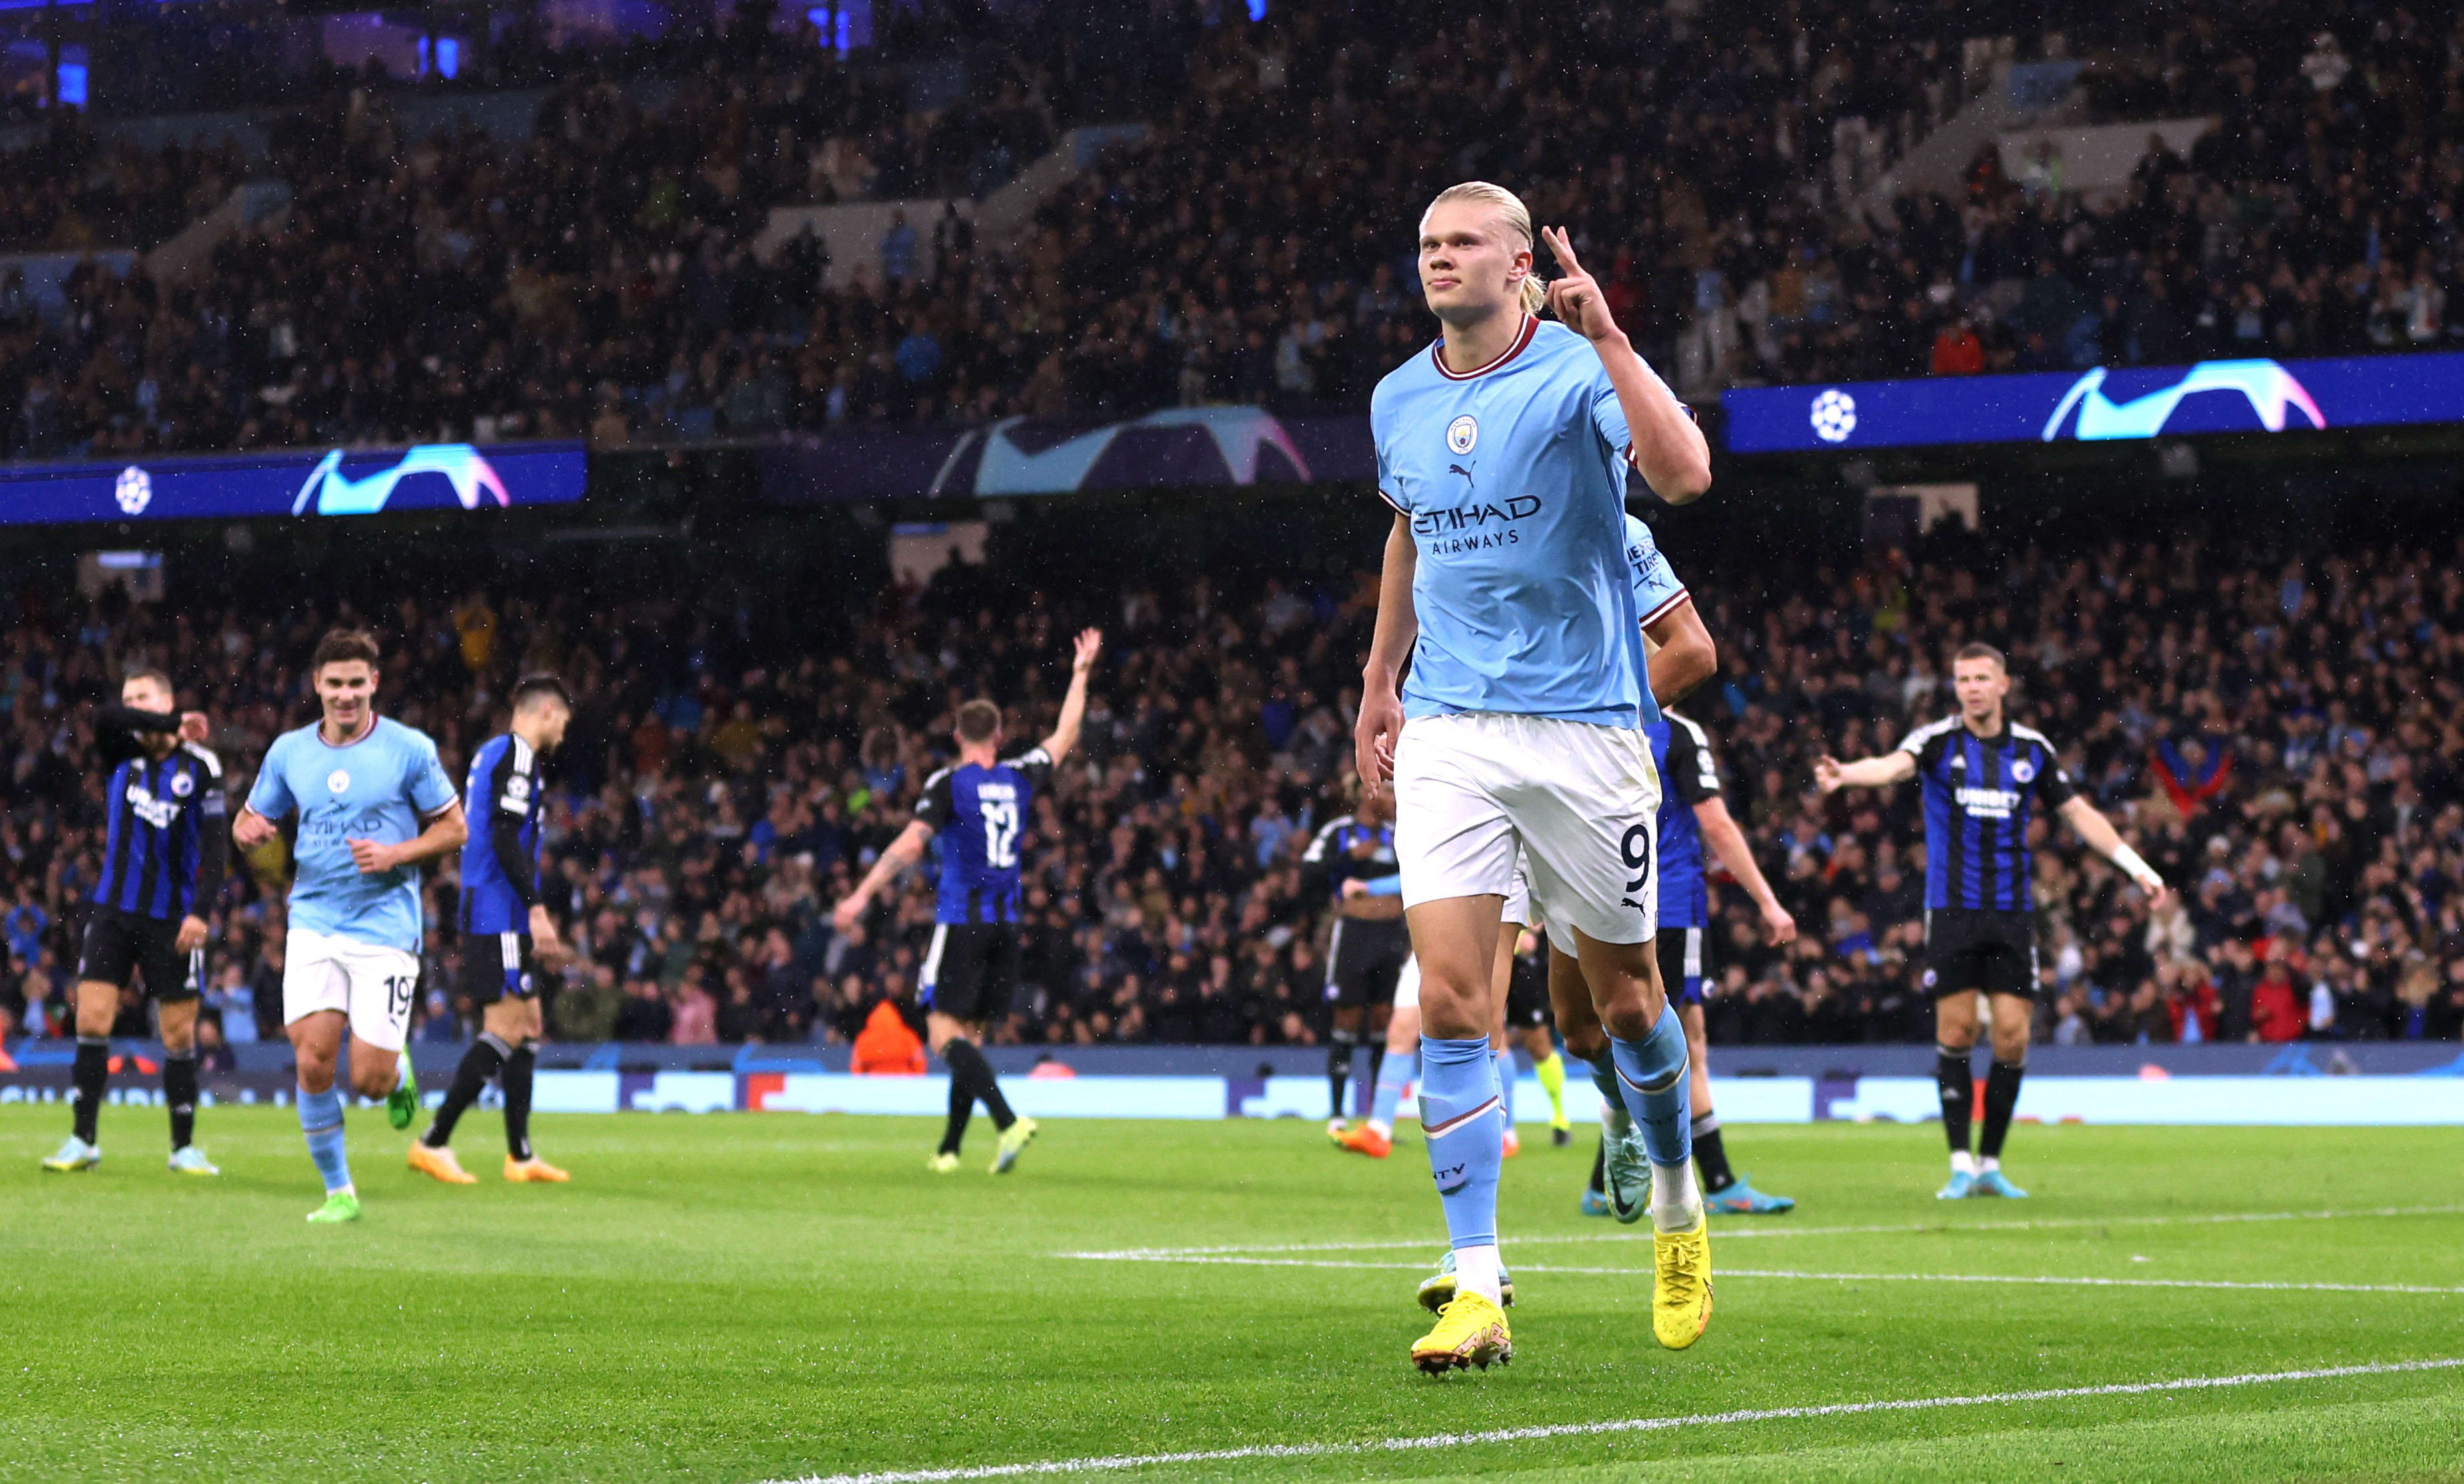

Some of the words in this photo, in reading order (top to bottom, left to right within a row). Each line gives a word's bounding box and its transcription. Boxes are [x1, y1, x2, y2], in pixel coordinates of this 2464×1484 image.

[1414, 495, 1542, 533] ETIHAD
[1433, 529, 1519, 555] AIRWAYS
[980, 801, 1018, 868] 12
[1621, 824, 1649, 892] 9
[384, 975, 410, 1016] 19
